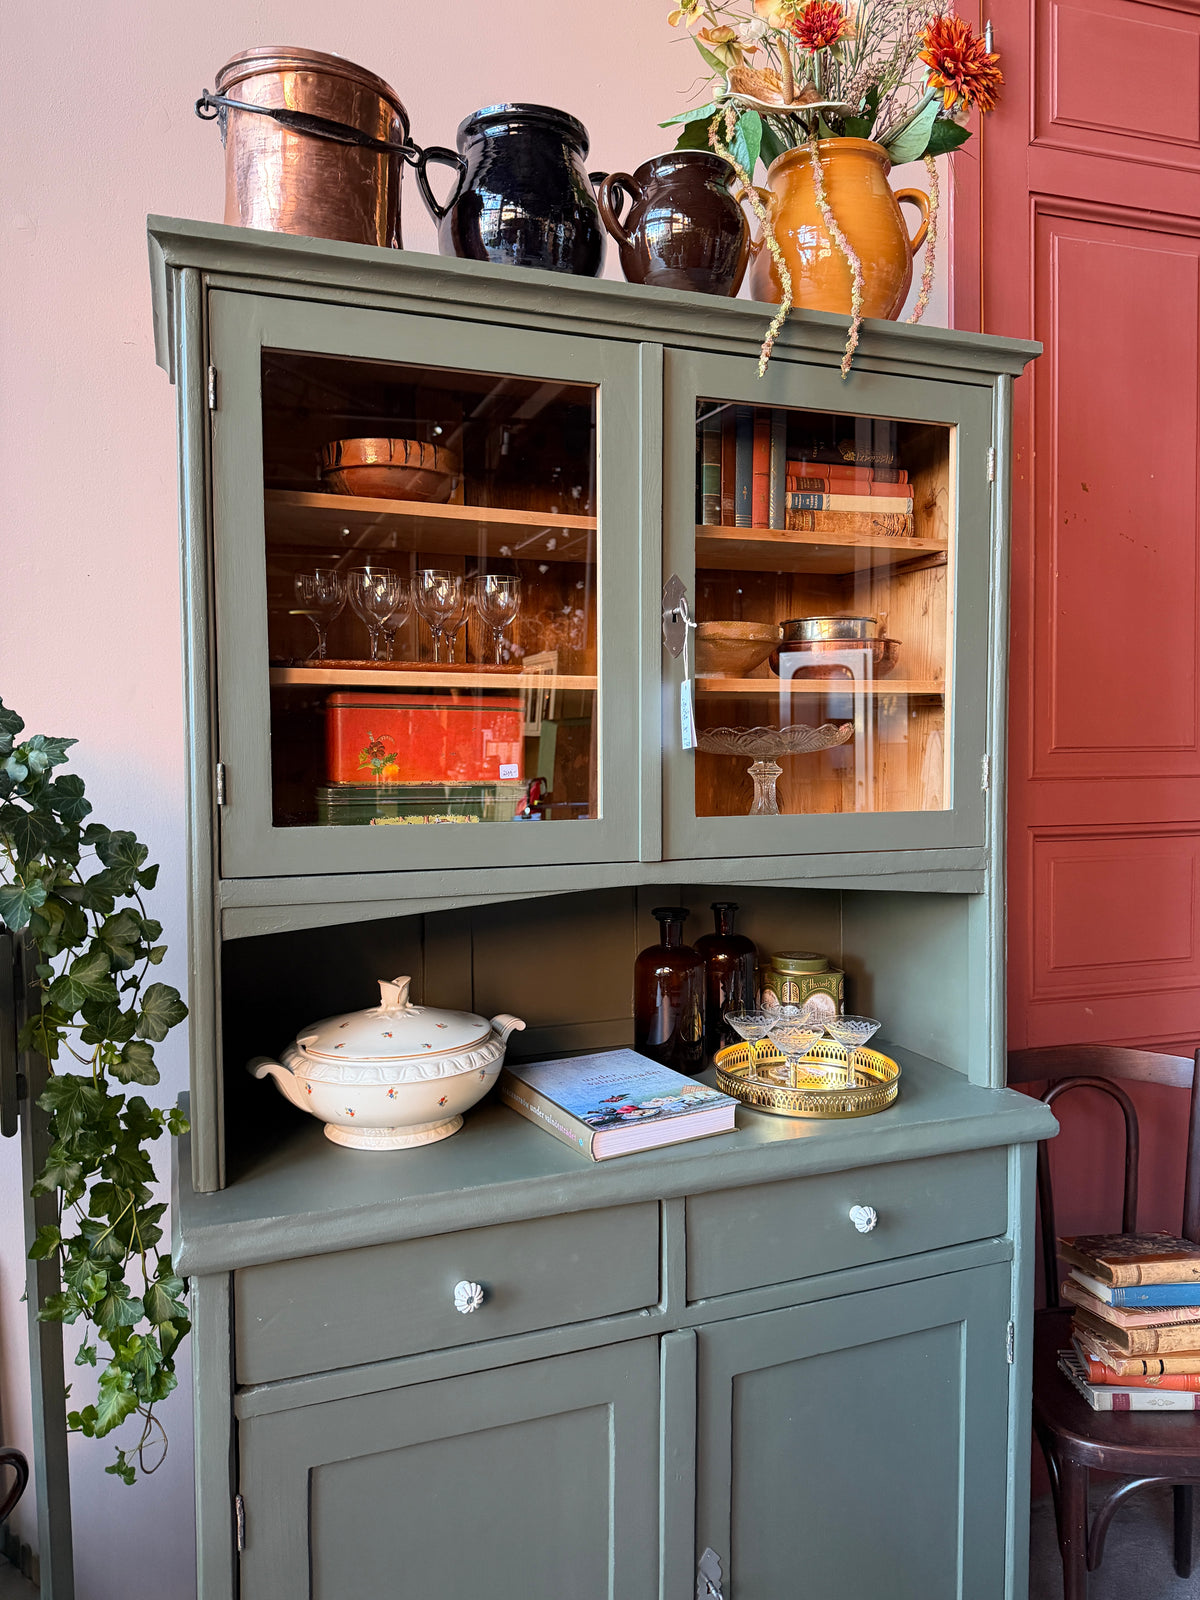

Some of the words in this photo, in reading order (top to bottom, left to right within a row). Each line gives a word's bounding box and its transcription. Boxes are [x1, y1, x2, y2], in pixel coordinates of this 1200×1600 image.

[809, 978, 831, 989] Harrods
[582, 1073, 618, 1083] under
[529, 1104, 545, 1119] under
